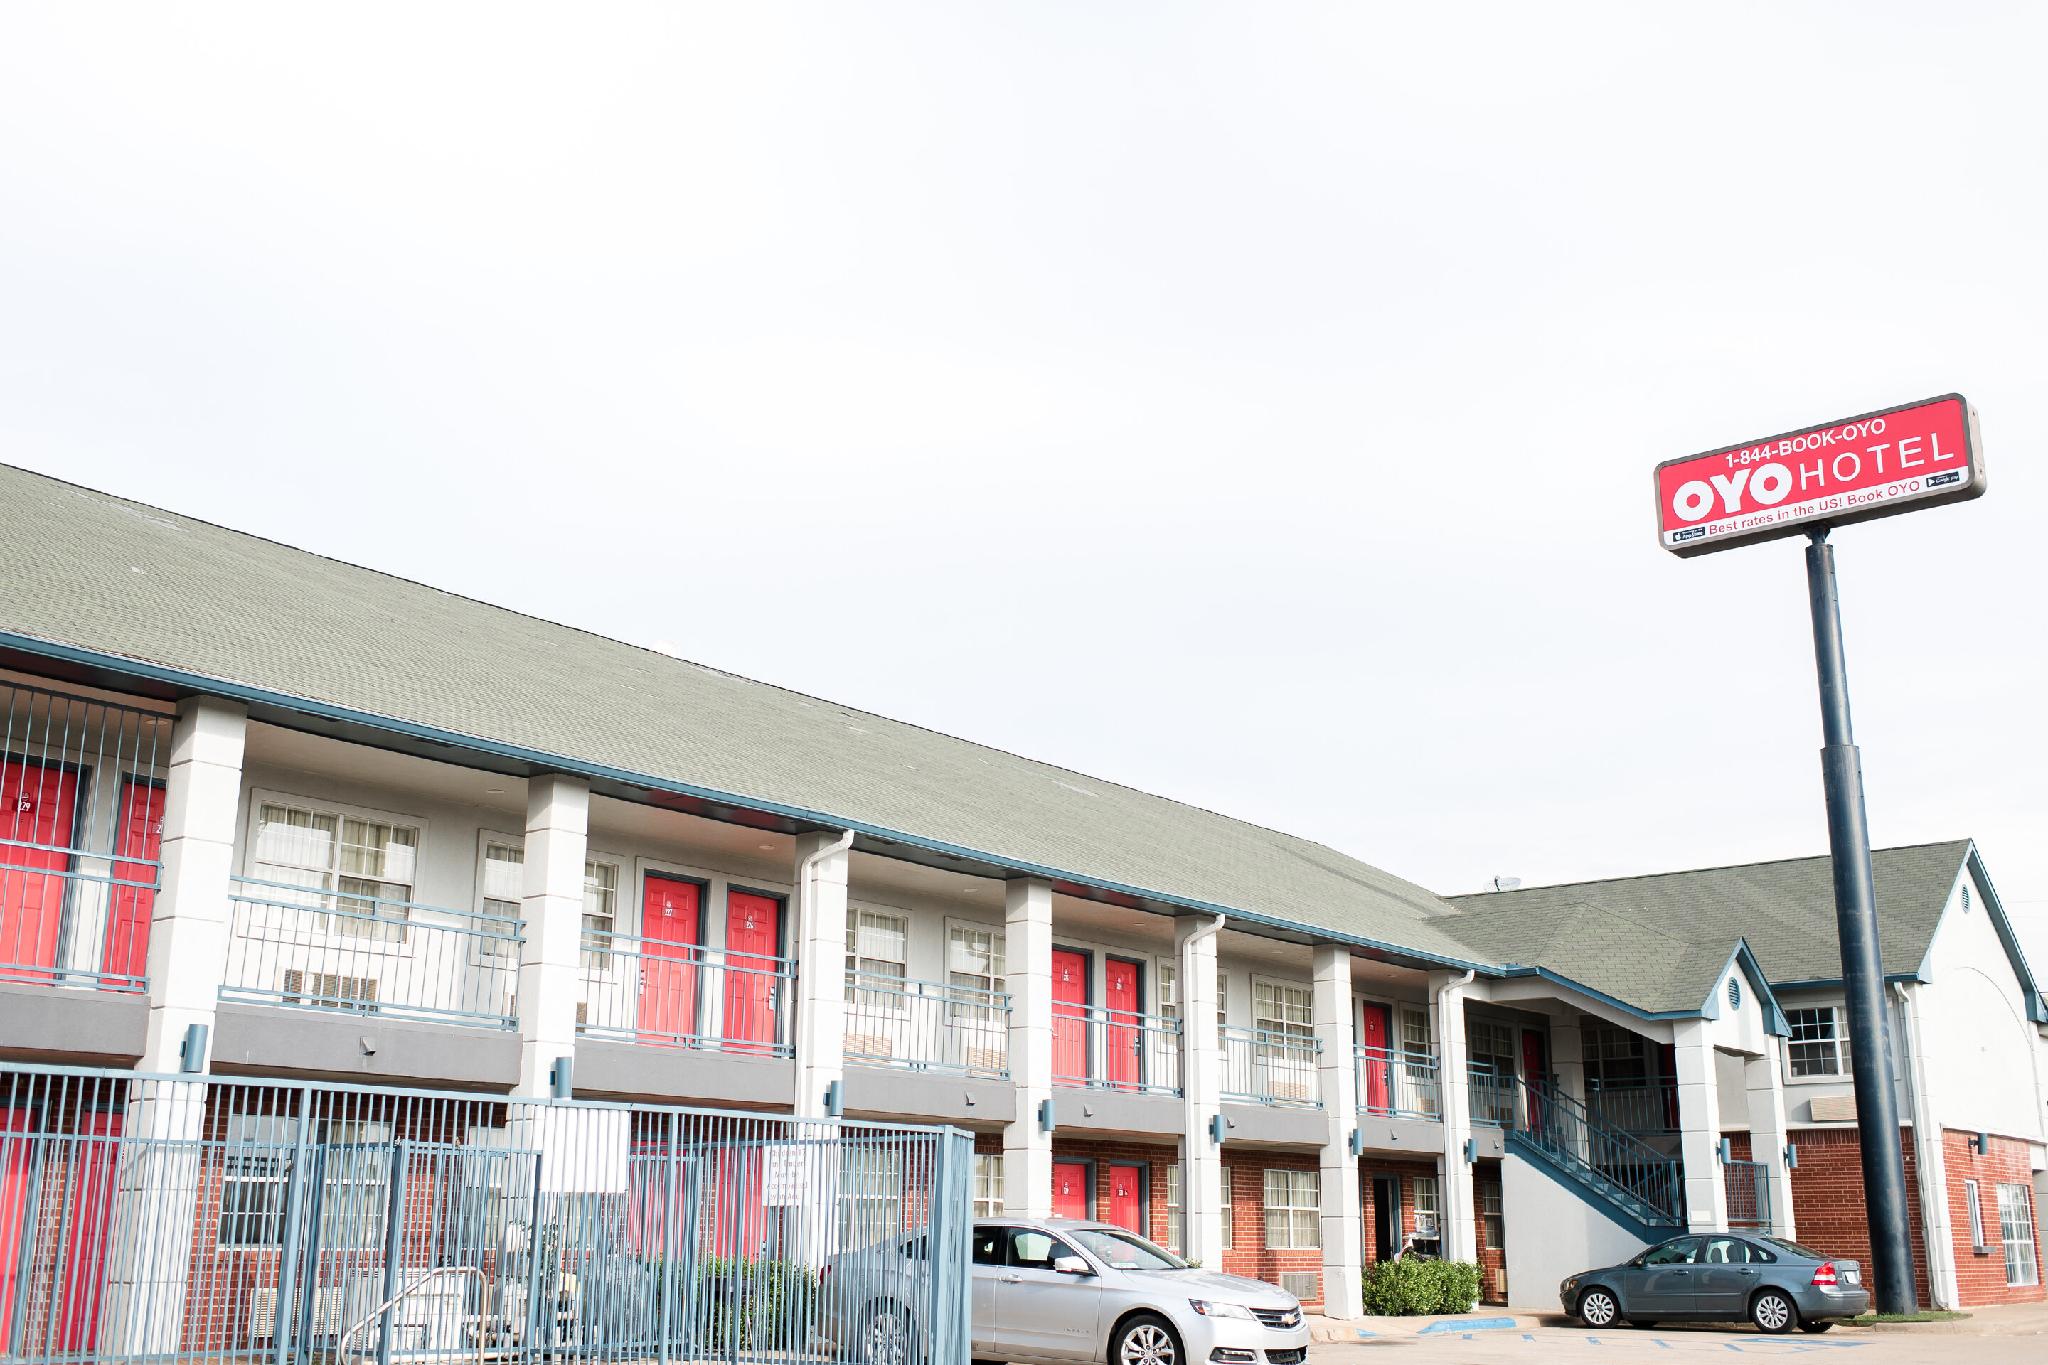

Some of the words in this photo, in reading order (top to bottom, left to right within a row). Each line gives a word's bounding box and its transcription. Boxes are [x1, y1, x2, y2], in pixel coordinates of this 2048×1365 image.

[1725, 418, 1886, 468] 1-844-BOOK-OYO
[1672, 462, 1793, 522] OYO
[1799, 432, 1954, 491] HOTEL
[1709, 520, 1738, 536] Best
[1741, 513, 1773, 529] rates
[1777, 509, 1789, 521] in
[1793, 503, 1814, 517] the
[1819, 494, 1843, 512] US!
[1847, 489, 1883, 506] Book
[1888, 480, 1920, 497] OYO
